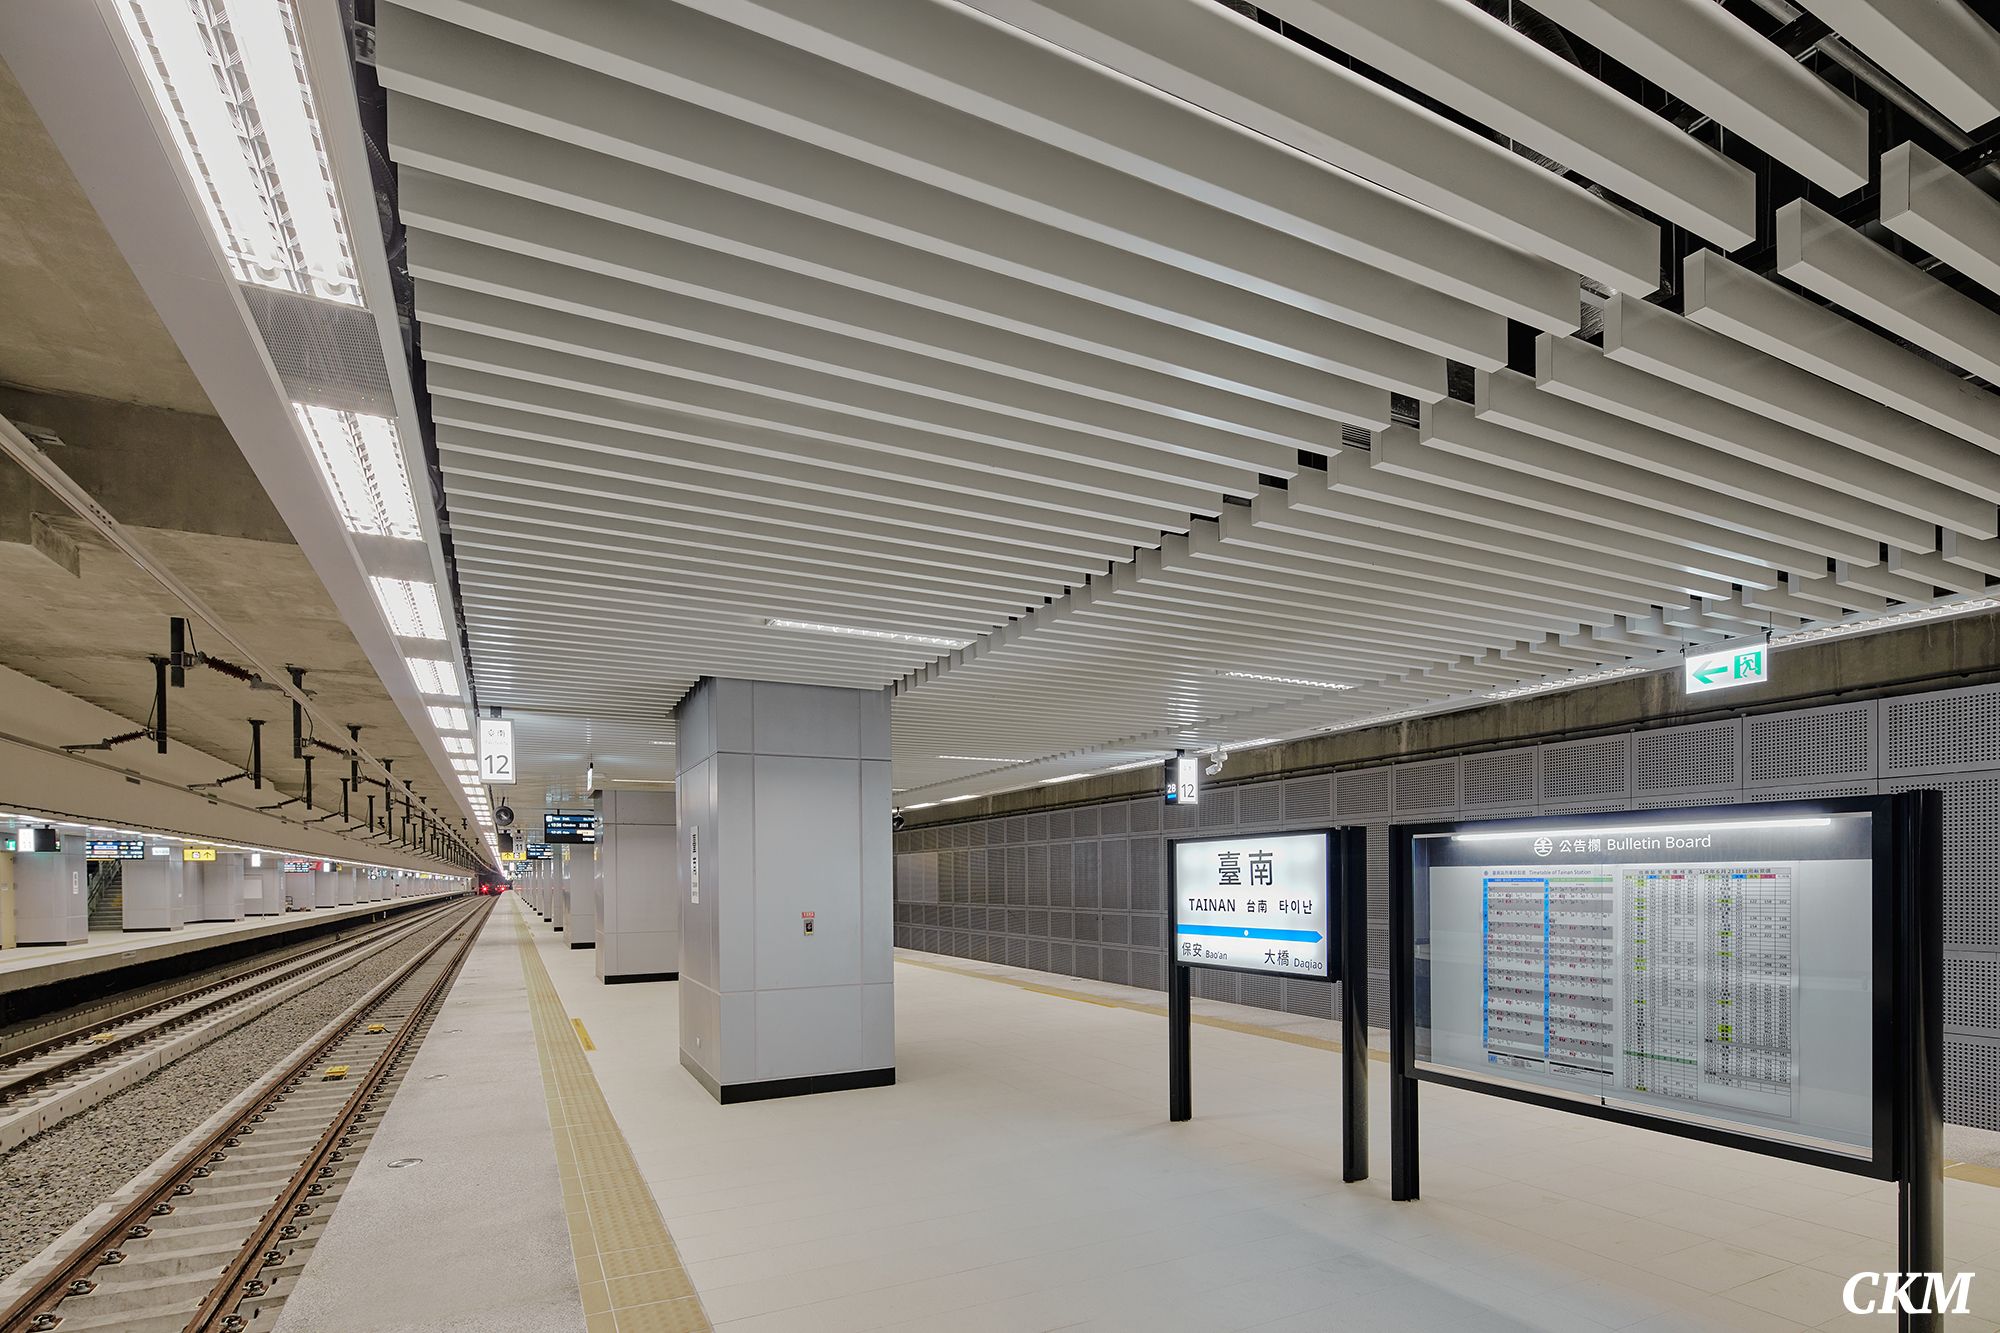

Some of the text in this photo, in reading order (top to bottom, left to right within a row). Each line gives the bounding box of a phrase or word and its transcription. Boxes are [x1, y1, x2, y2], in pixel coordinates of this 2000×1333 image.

[484, 754, 510, 775] 12
[1181, 783, 1195, 798] 12
[1559, 834, 1711, 852] 公告欄 Bulletin Board
[1217, 849, 1273, 886] 臺南
[1188, 898, 1313, 915] TAINAN 台南 타이난
[1181, 942, 1228, 960] 保安 Bao'an
[1264, 948, 1323, 970] 大橋 Daqiao
